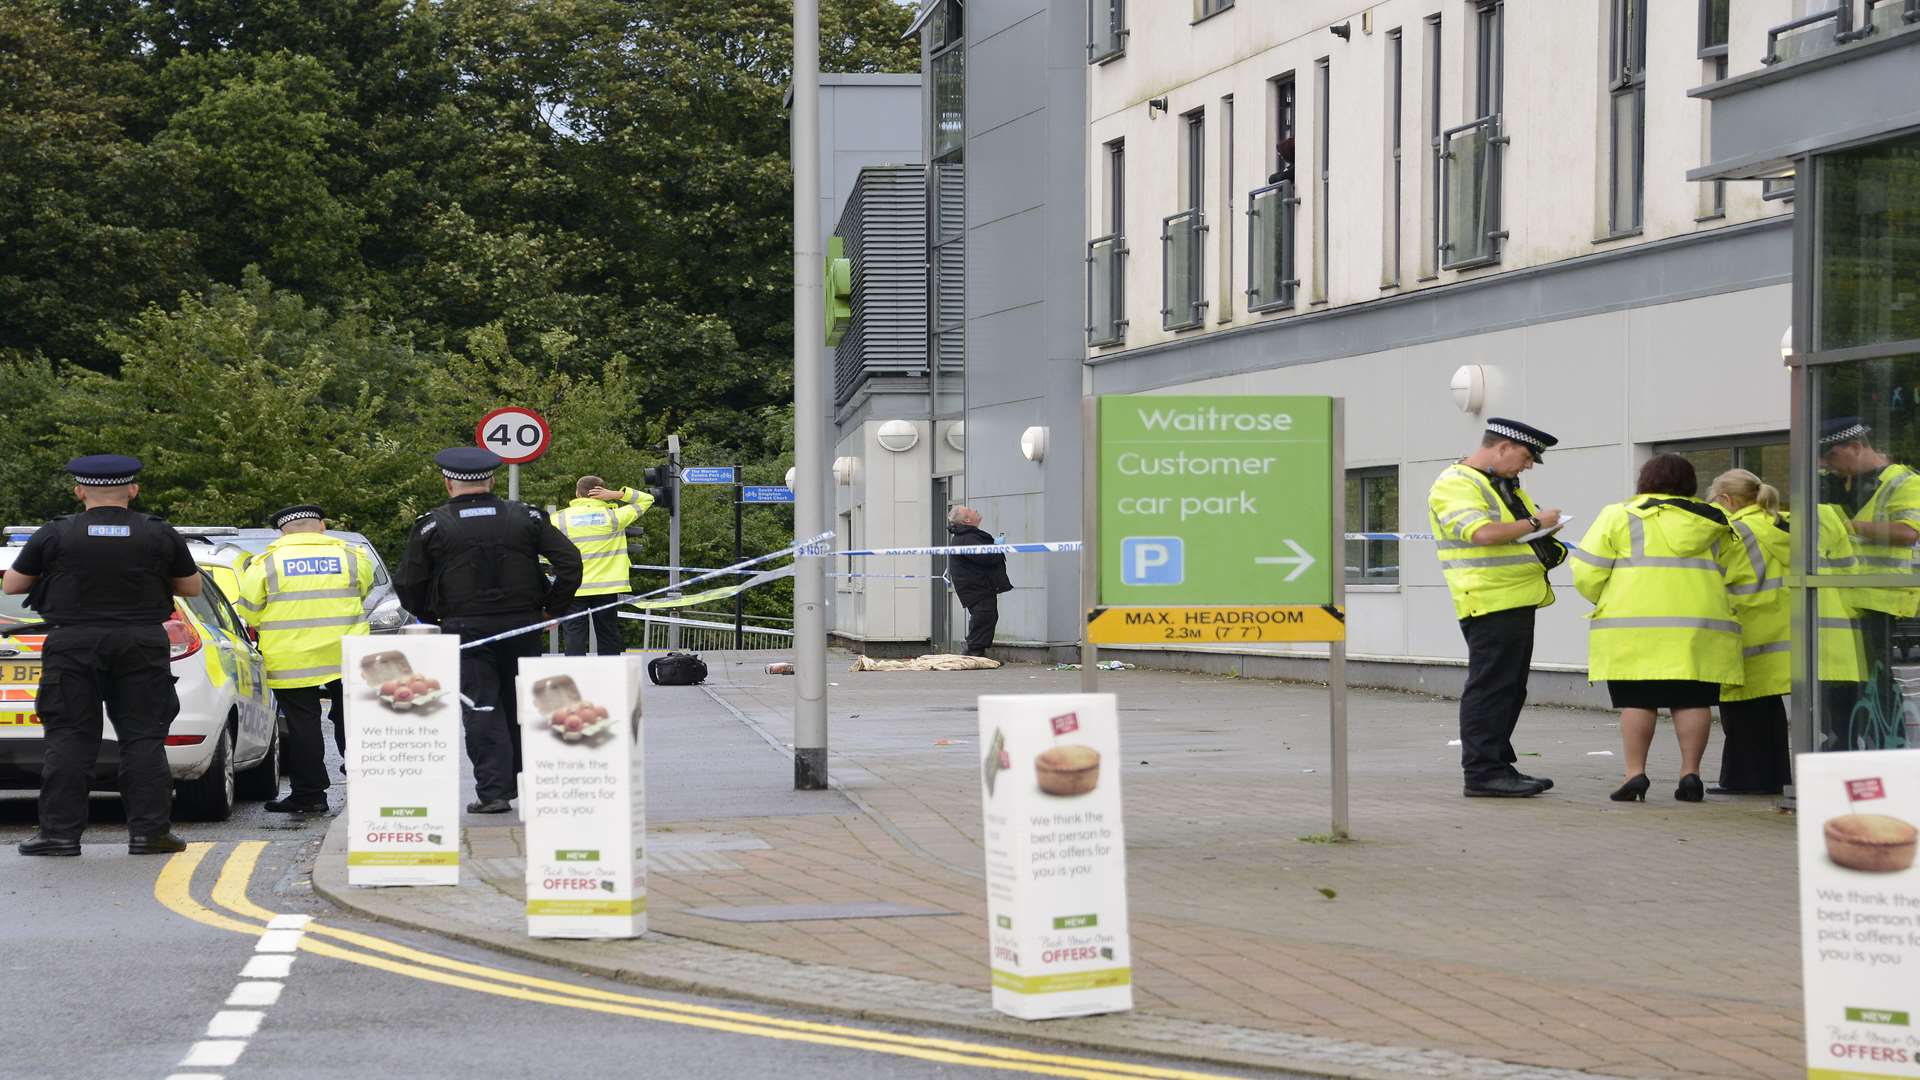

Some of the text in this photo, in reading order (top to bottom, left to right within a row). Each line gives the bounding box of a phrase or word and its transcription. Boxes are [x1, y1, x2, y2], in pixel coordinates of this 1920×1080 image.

[1138, 407, 1292, 431] Waitrose
[486, 424, 540, 447] 40
[1117, 451, 1277, 475] Customer
[1118, 490, 1258, 522] car park
[90, 526, 128, 535] POLICE
[286, 559, 339, 574] POLICE
[1135, 544, 1169, 579] P
[1125, 611, 1304, 625] MAX. HEADROOM
[362, 726, 439, 736] We think the
[361, 740, 447, 752] best person to
[361, 752, 447, 765] pick offers for
[536, 760, 609, 770] We think the
[361, 767, 423, 778] you is you
[536, 775, 616, 788] best person to
[536, 789, 617, 801] pick offers for
[536, 805, 594, 816] you is you
[1030, 811, 1103, 827] We think the
[366, 832, 424, 843] OFFERS
[1030, 828, 1111, 847] best person to
[566, 852, 588, 860] NEW
[1031, 845, 1111, 864] pick offers for
[1031, 864, 1092, 880] you is you
[543, 879, 597, 890] OFFERS
[1816, 889, 1920, 908] We think the
[1064, 917, 1087, 927] NEW
[1817, 908, 1850, 922] best
[1854, 912, 1913, 928] person
[1818, 928, 1849, 943] pick
[1855, 930, 1905, 946] offers
[1042, 946, 1097, 963] OFFERS
[1819, 948, 1902, 968] you is you
[1861, 1012, 1893, 1024] NEW
[1830, 1043, 1908, 1063] OFFERS
